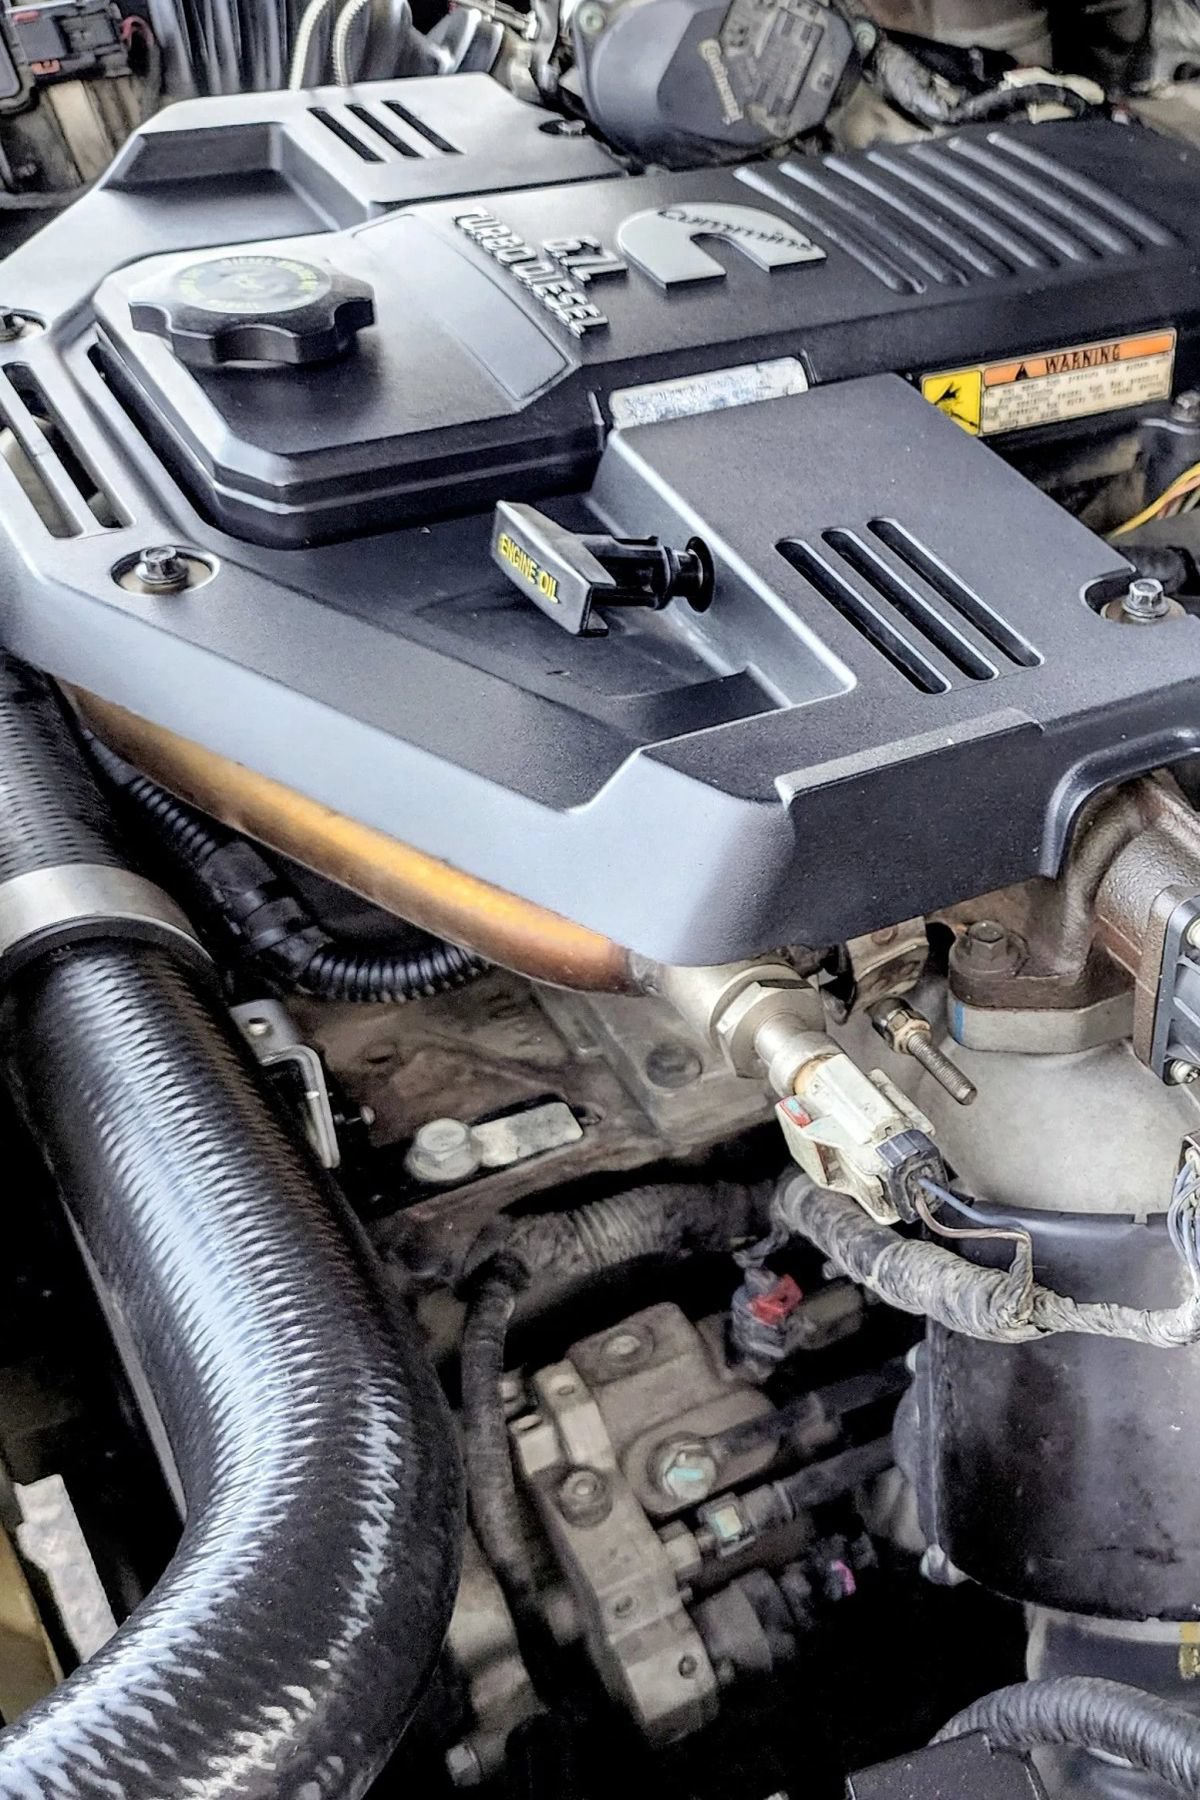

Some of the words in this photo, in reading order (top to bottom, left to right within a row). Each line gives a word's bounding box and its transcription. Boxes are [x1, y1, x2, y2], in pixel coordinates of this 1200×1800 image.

[657, 207, 817, 251] Cummins
[451, 206, 538, 267] TURBO
[510, 261, 610, 340] DIESEL
[1045, 344, 1121, 375] WARNING
[498, 532, 541, 585] ENGINE
[538, 570, 560, 604] OIL
